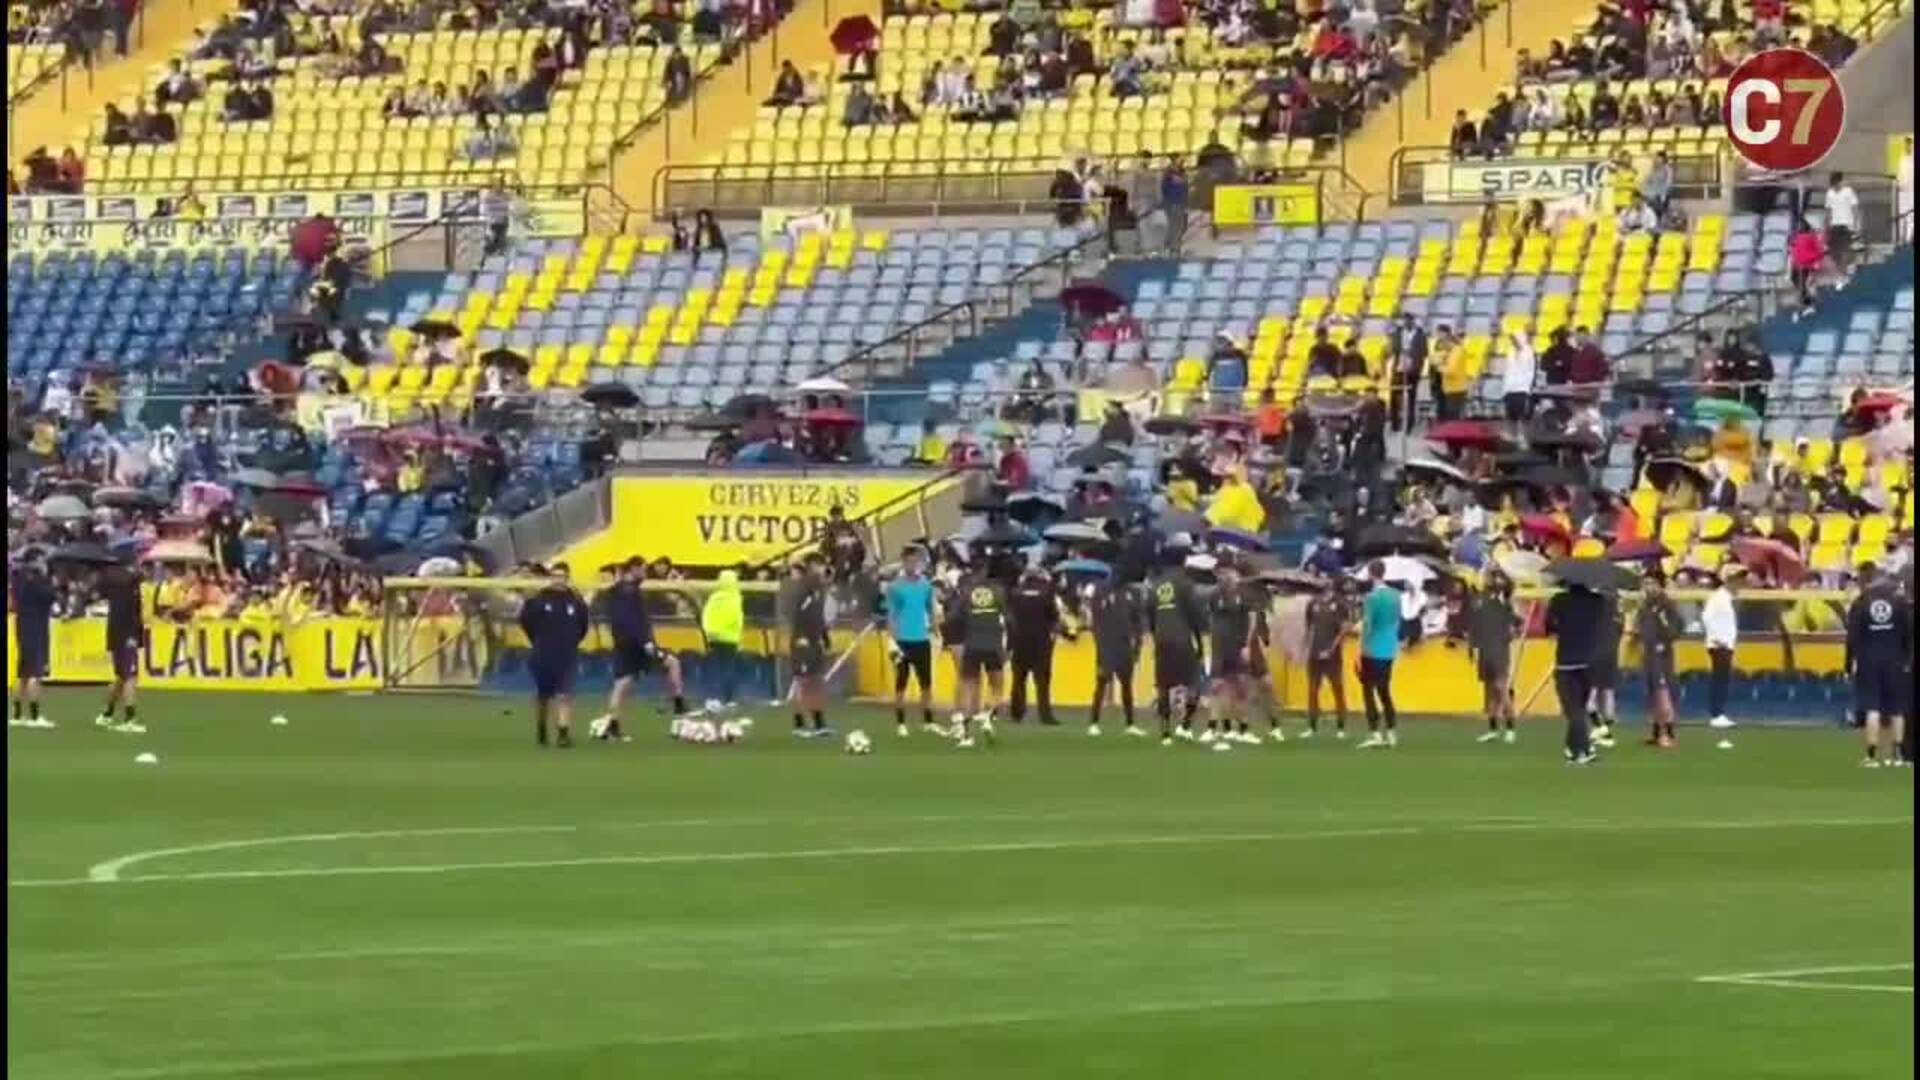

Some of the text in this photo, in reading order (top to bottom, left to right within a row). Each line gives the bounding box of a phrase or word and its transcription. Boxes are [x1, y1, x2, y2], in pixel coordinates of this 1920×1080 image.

[1481, 169, 1585, 192] SPAR
[709, 483, 860, 507] CERVEZAS
[143, 628, 378, 679] LALIGA LA
